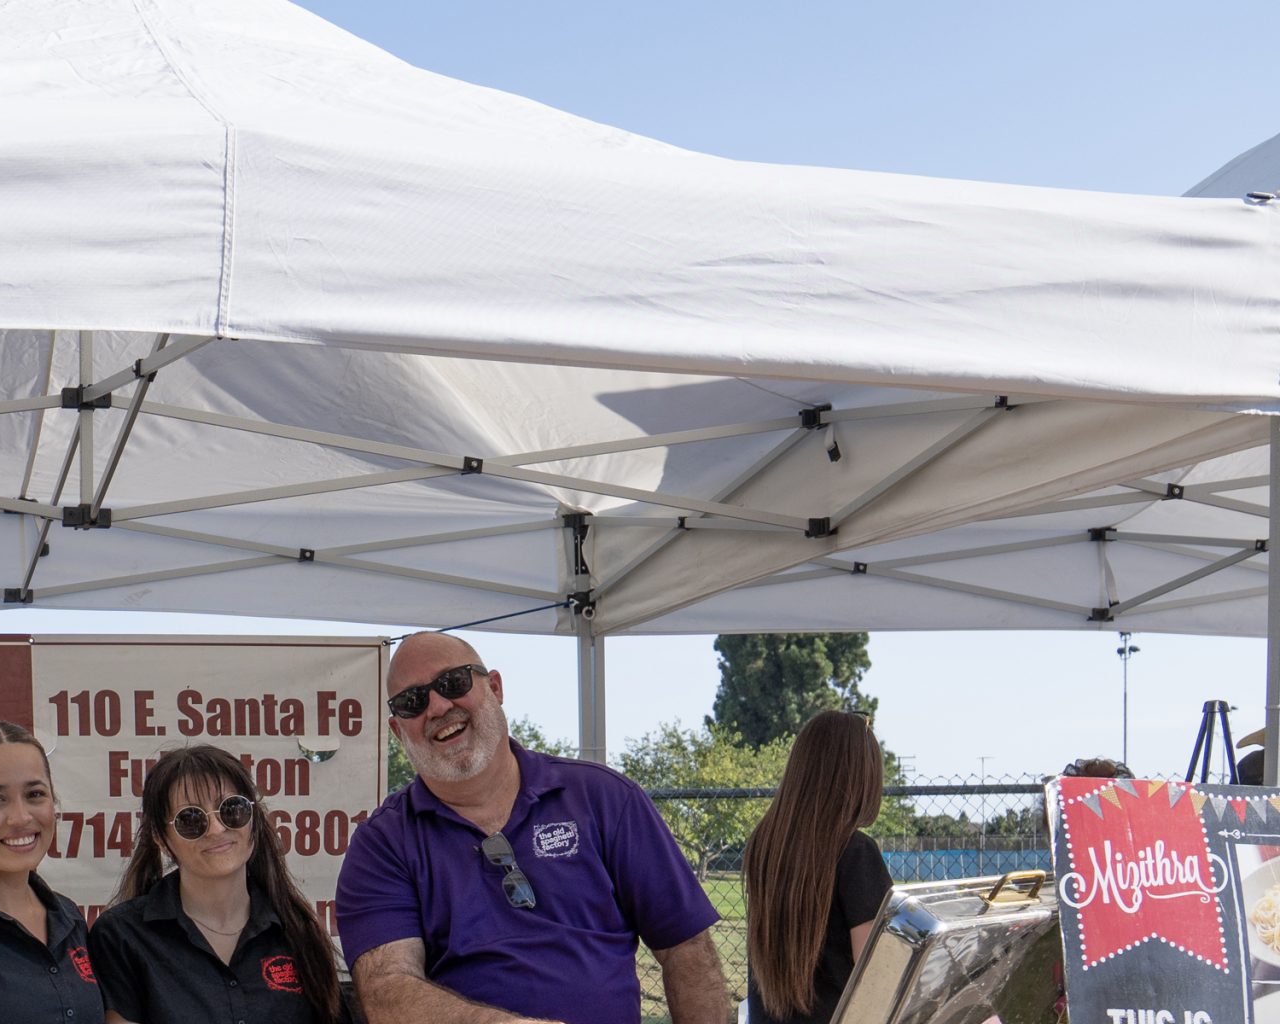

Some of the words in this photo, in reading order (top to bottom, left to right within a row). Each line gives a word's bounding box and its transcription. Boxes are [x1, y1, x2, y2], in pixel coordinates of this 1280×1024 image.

[48, 690, 122, 738] 110
[134, 690, 167, 737] E.
[176, 690, 305, 738] Santa
[317, 691, 363, 738] Fe
[552, 827, 565, 836] old
[1059, 839, 1229, 914] Mizithra
